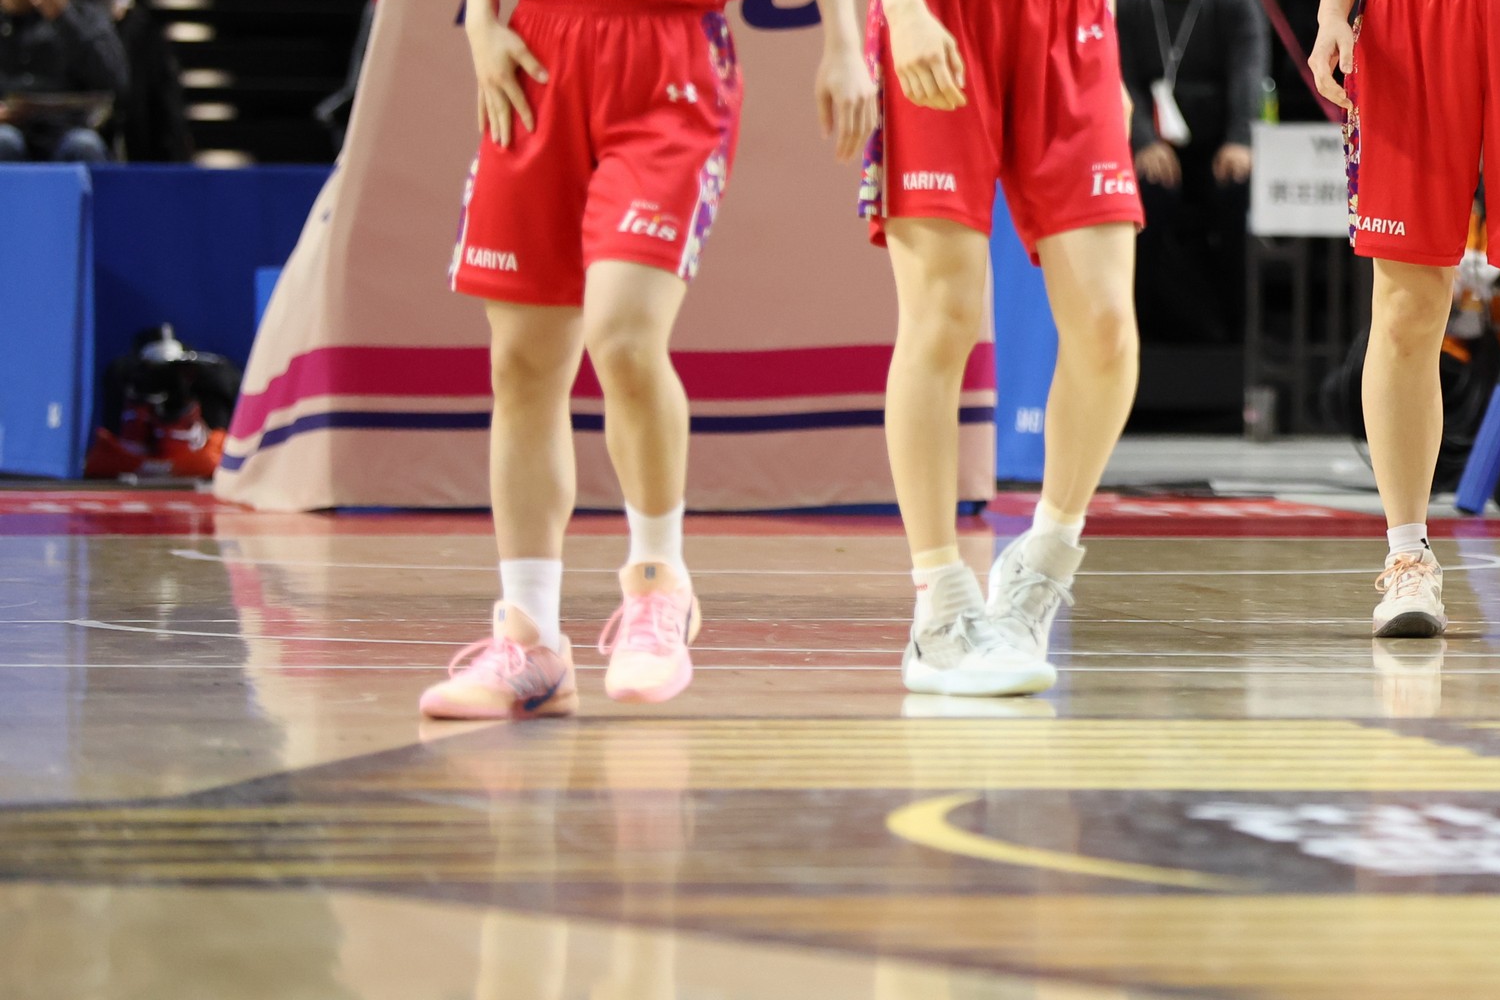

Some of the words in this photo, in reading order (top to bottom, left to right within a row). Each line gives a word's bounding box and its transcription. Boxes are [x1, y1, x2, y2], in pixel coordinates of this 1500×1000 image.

[903, 171, 957, 193] KARIYA
[1091, 172, 1136, 197] Iris
[616, 209, 678, 243] Iris
[1355, 214, 1406, 236] KARIYA
[465, 245, 518, 272] KARIYA
